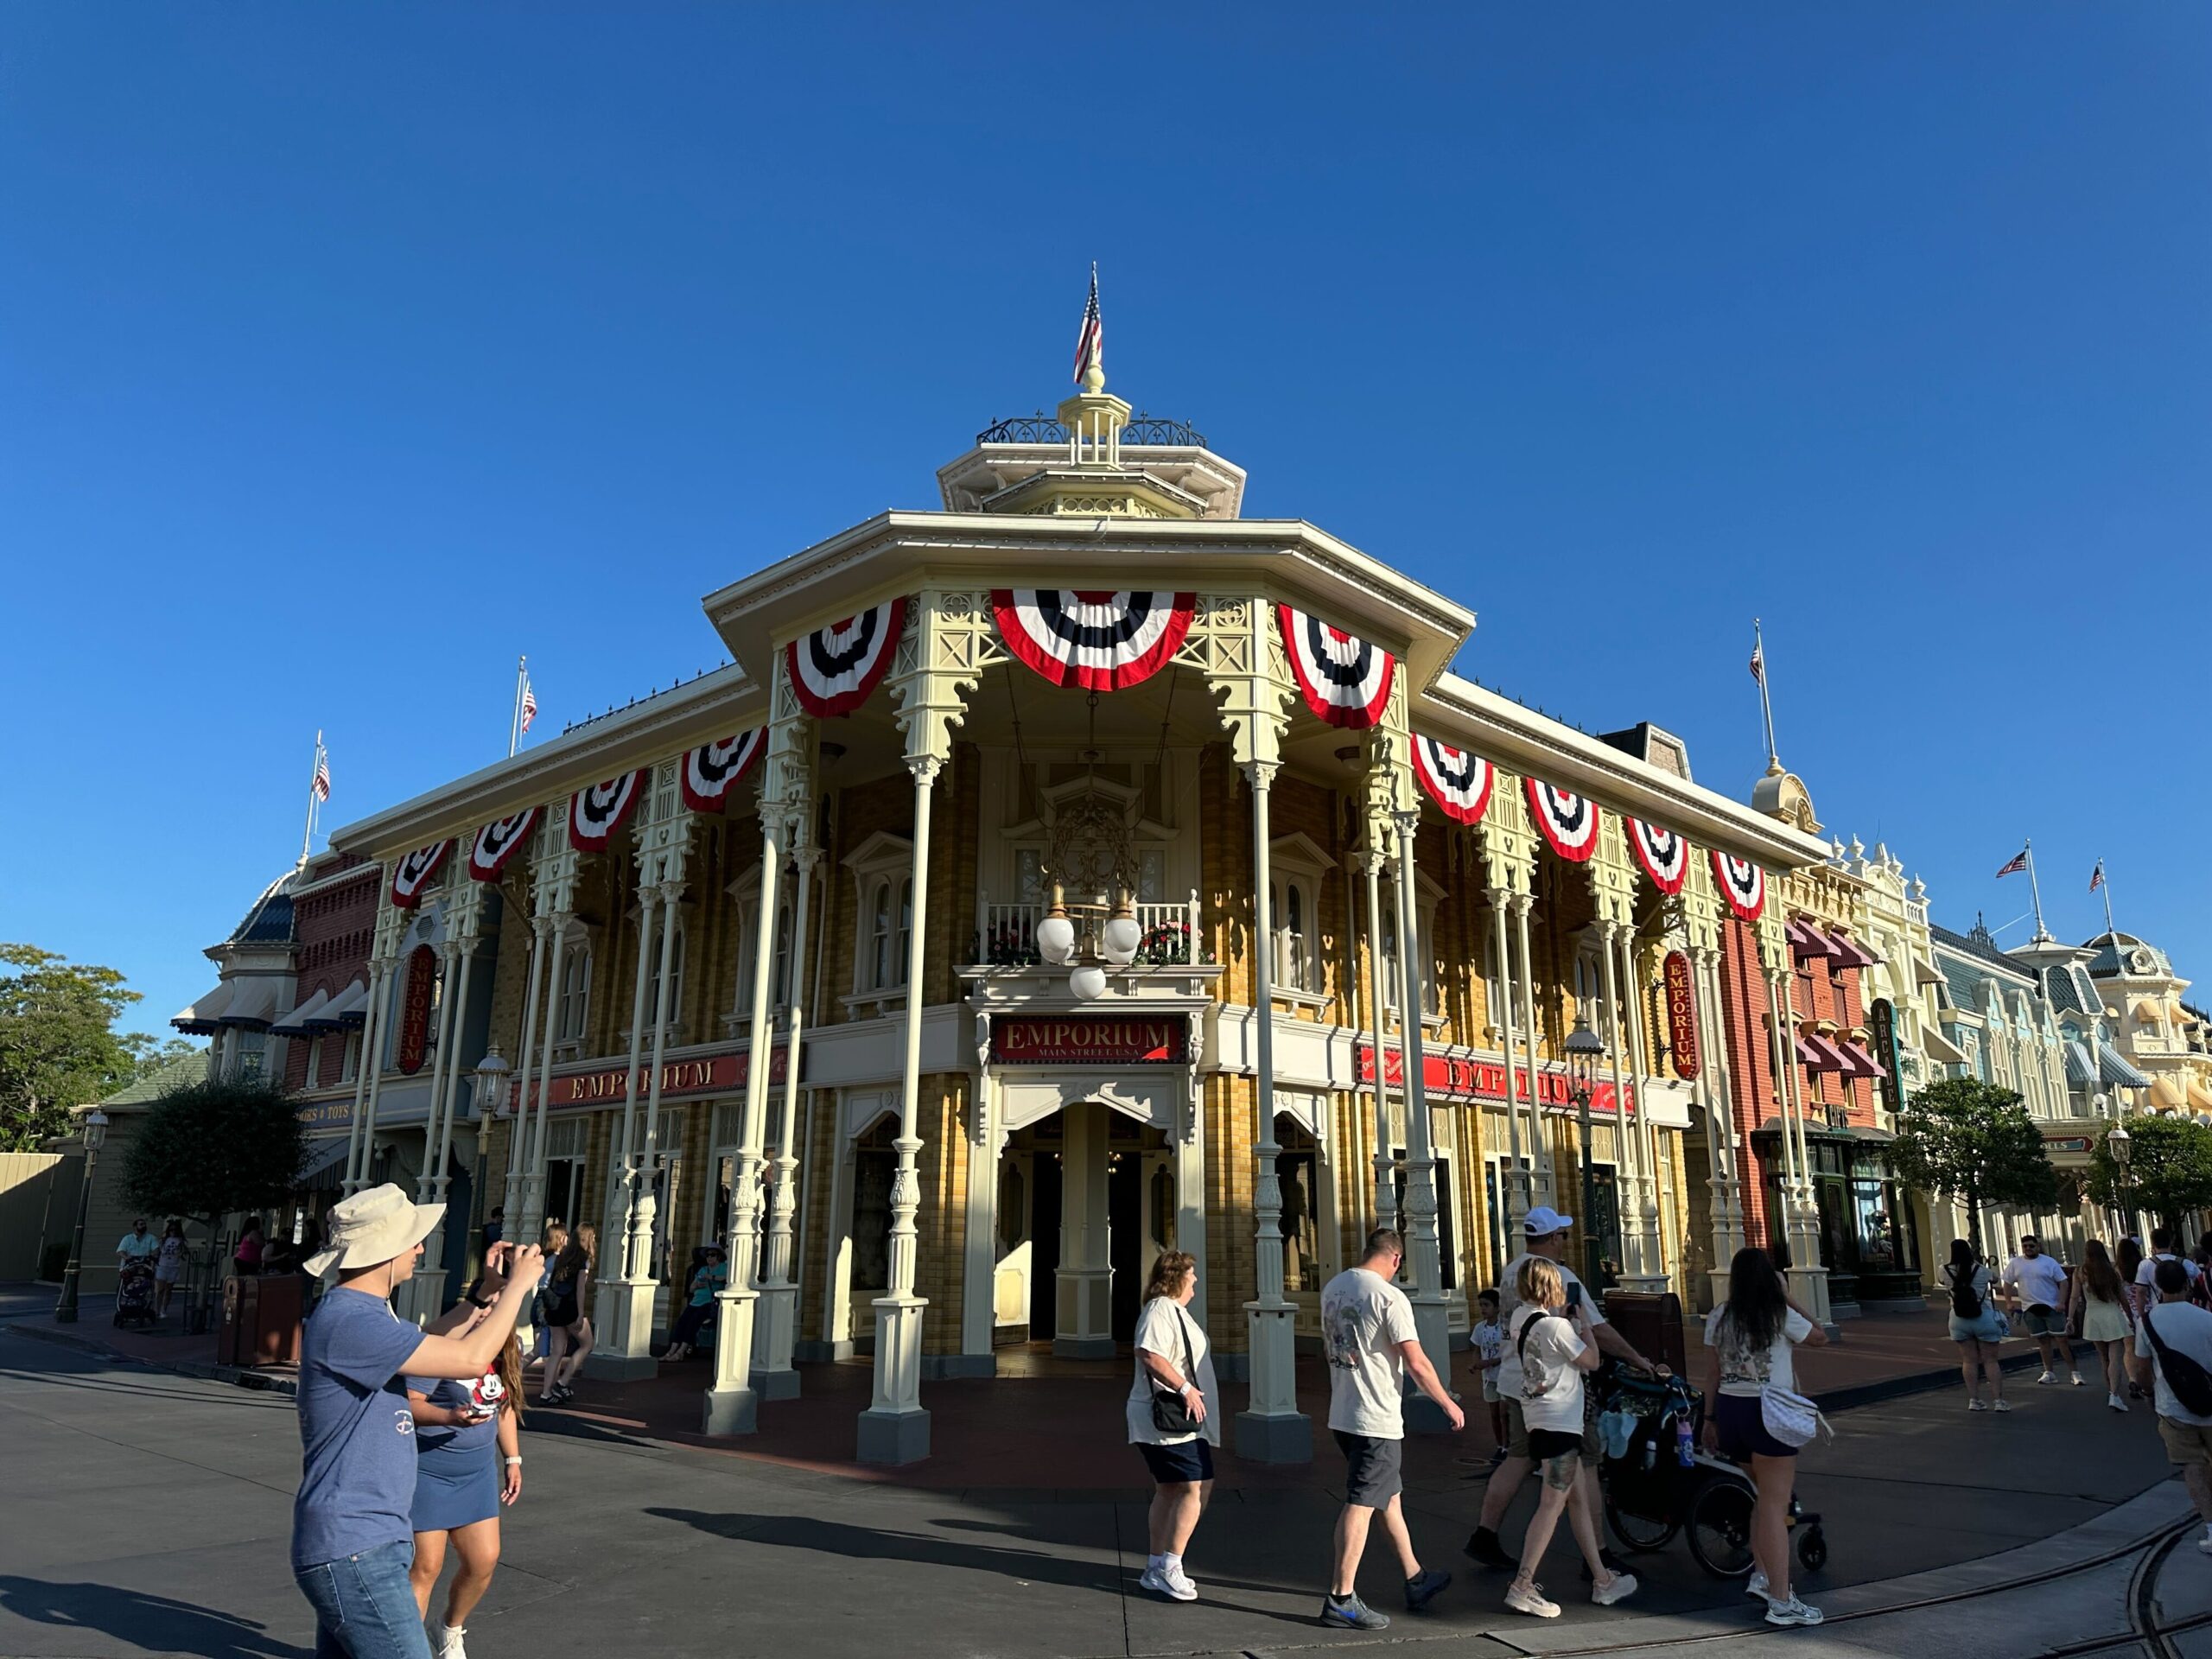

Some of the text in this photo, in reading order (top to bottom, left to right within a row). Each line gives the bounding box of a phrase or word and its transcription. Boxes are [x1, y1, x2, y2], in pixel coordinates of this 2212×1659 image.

[406, 957, 429, 1060] EMPORIUM
[1006, 1024, 1170, 1049] EMPORIUM
[1669, 964, 1692, 1065] EMPORIUM
[1878, 1008, 1895, 1103] ARCADE
[327, 1105, 349, 1120] TOYS
